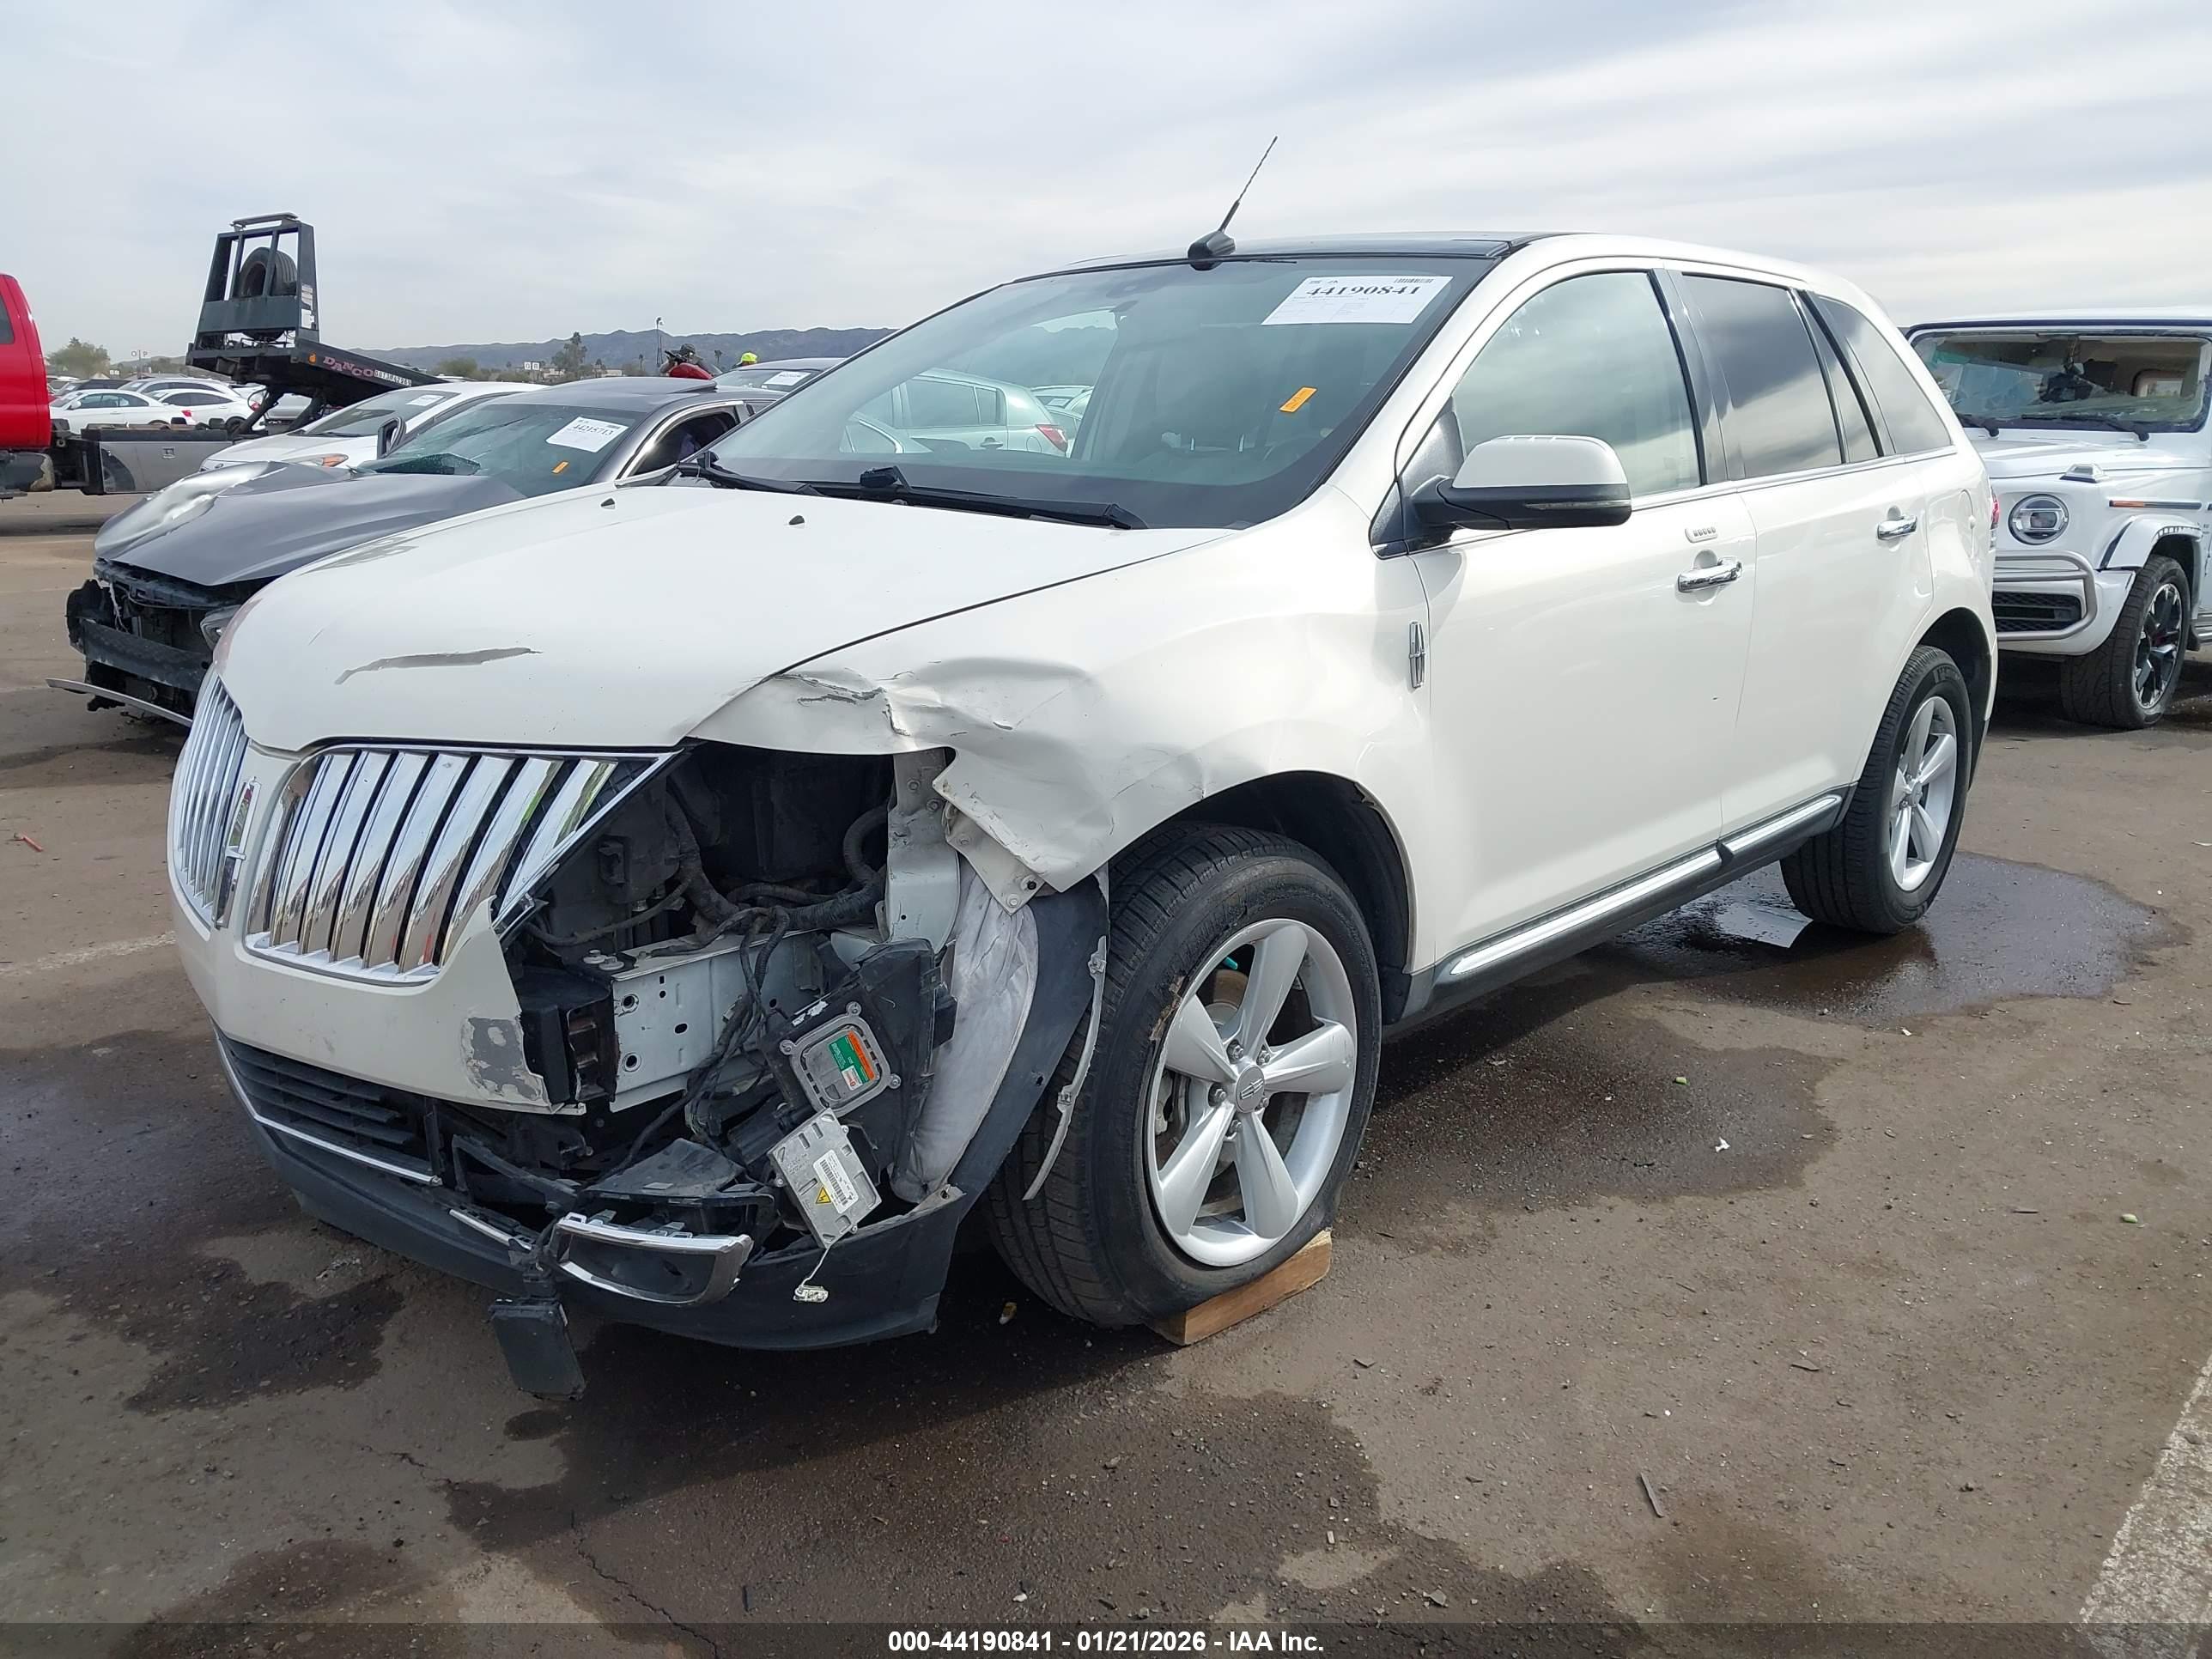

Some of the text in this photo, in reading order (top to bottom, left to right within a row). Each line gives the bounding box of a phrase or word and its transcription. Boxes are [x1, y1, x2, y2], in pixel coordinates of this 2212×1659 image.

[1306, 286, 1420, 295] 44190841
[323, 356, 374, 377] DANCO
[573, 423, 614, 436] 44215713
